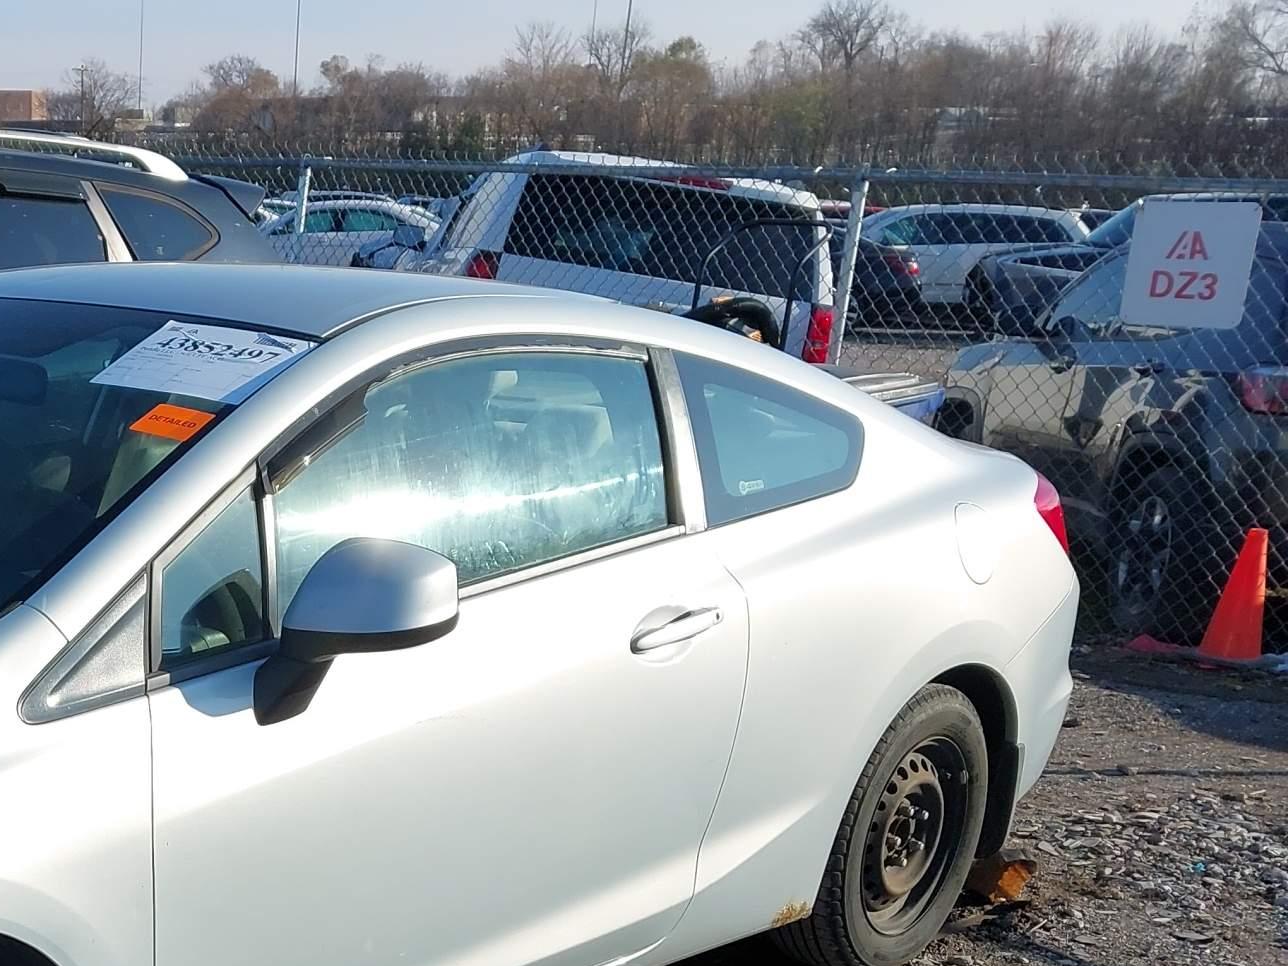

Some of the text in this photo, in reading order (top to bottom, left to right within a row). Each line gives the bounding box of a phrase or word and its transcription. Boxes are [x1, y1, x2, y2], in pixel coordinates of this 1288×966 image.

[1148, 269, 1219, 300] DZ3
[157, 336, 280, 364] 43852497
[148, 414, 197, 429] DETAILED
